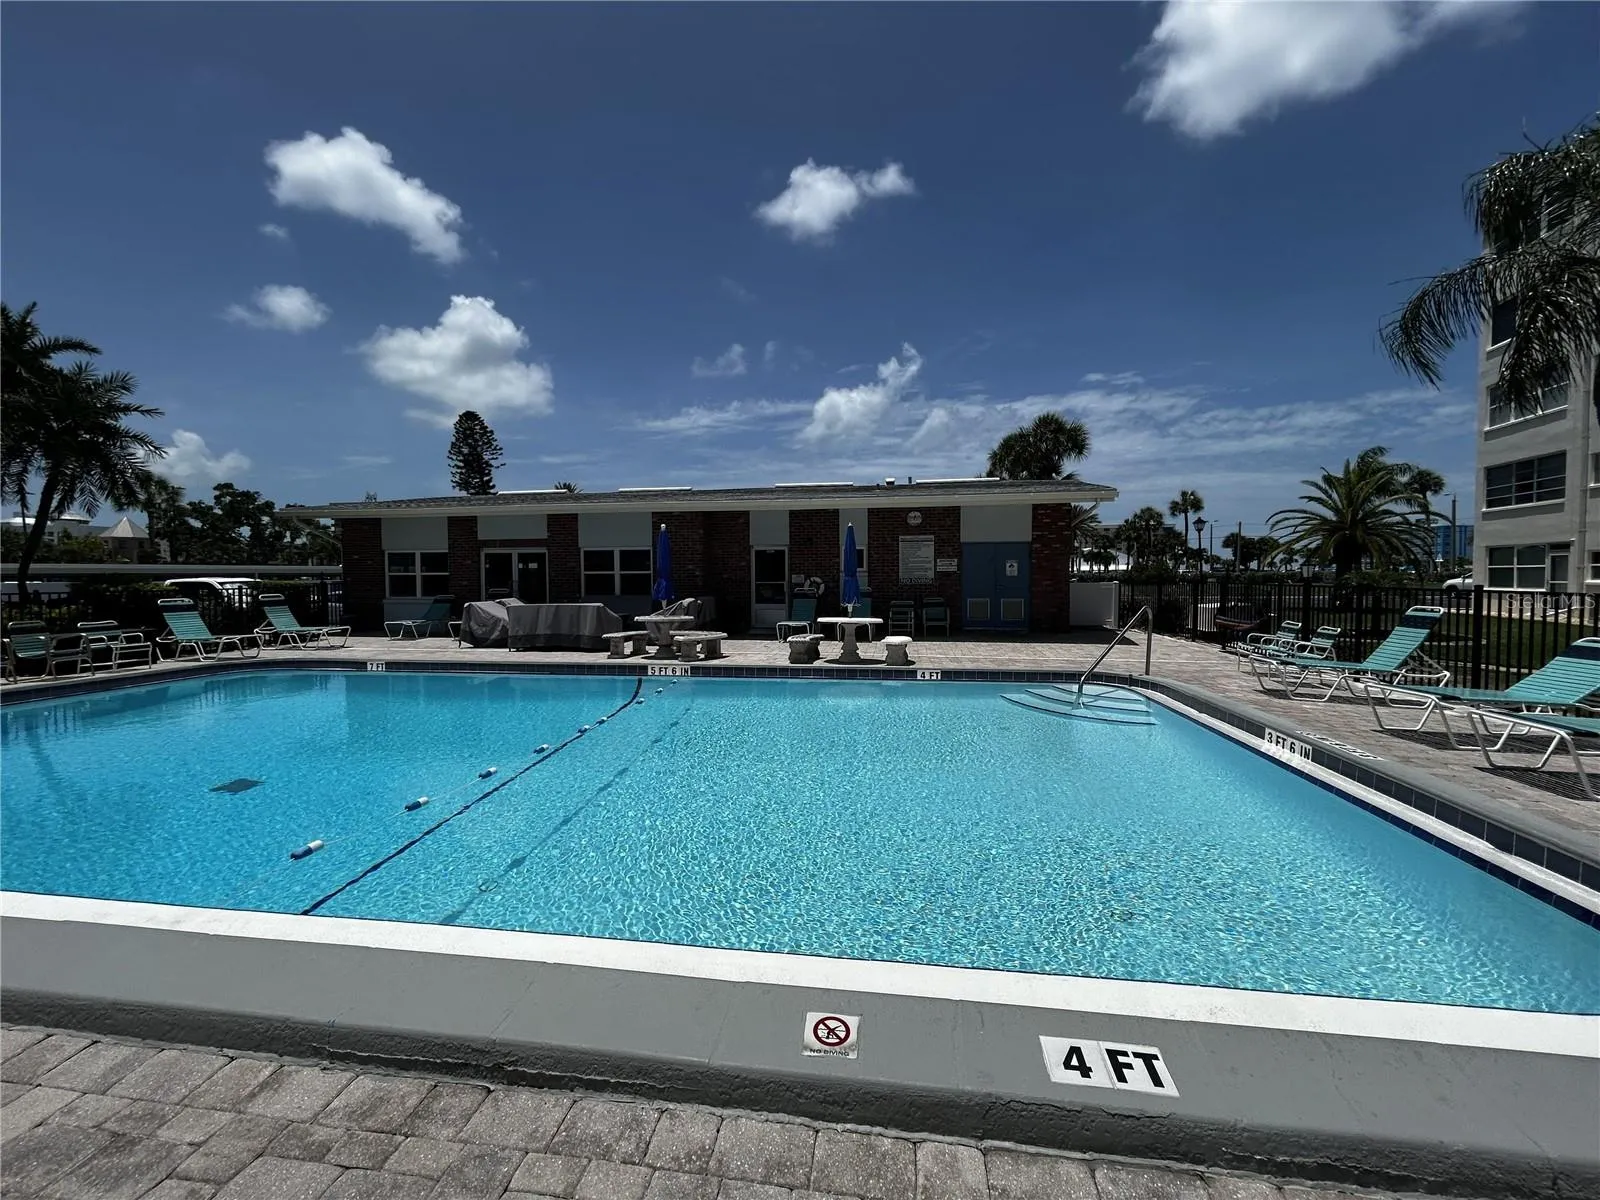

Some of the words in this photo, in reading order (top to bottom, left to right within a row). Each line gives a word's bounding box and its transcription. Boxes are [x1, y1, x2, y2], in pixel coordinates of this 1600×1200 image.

[369, 662, 374, 671] 7
[376, 662, 384, 671] FT
[650, 666, 656, 675] 5
[659, 666, 668, 675] FT
[671, 666, 677, 675] 6
[680, 667, 689, 676] IN
[920, 671, 926, 679] 4
[929, 671, 940, 680] FT
[1267, 732, 1273, 744] 3
[1275, 735, 1287, 750] FT
[1289, 741, 1296, 754] 6
[1300, 745, 1311, 760] IN
[823, 1049, 850, 1057] DIVING
[1062, 1045, 1093, 1079] 4
[1105, 1048, 1165, 1088] FT
